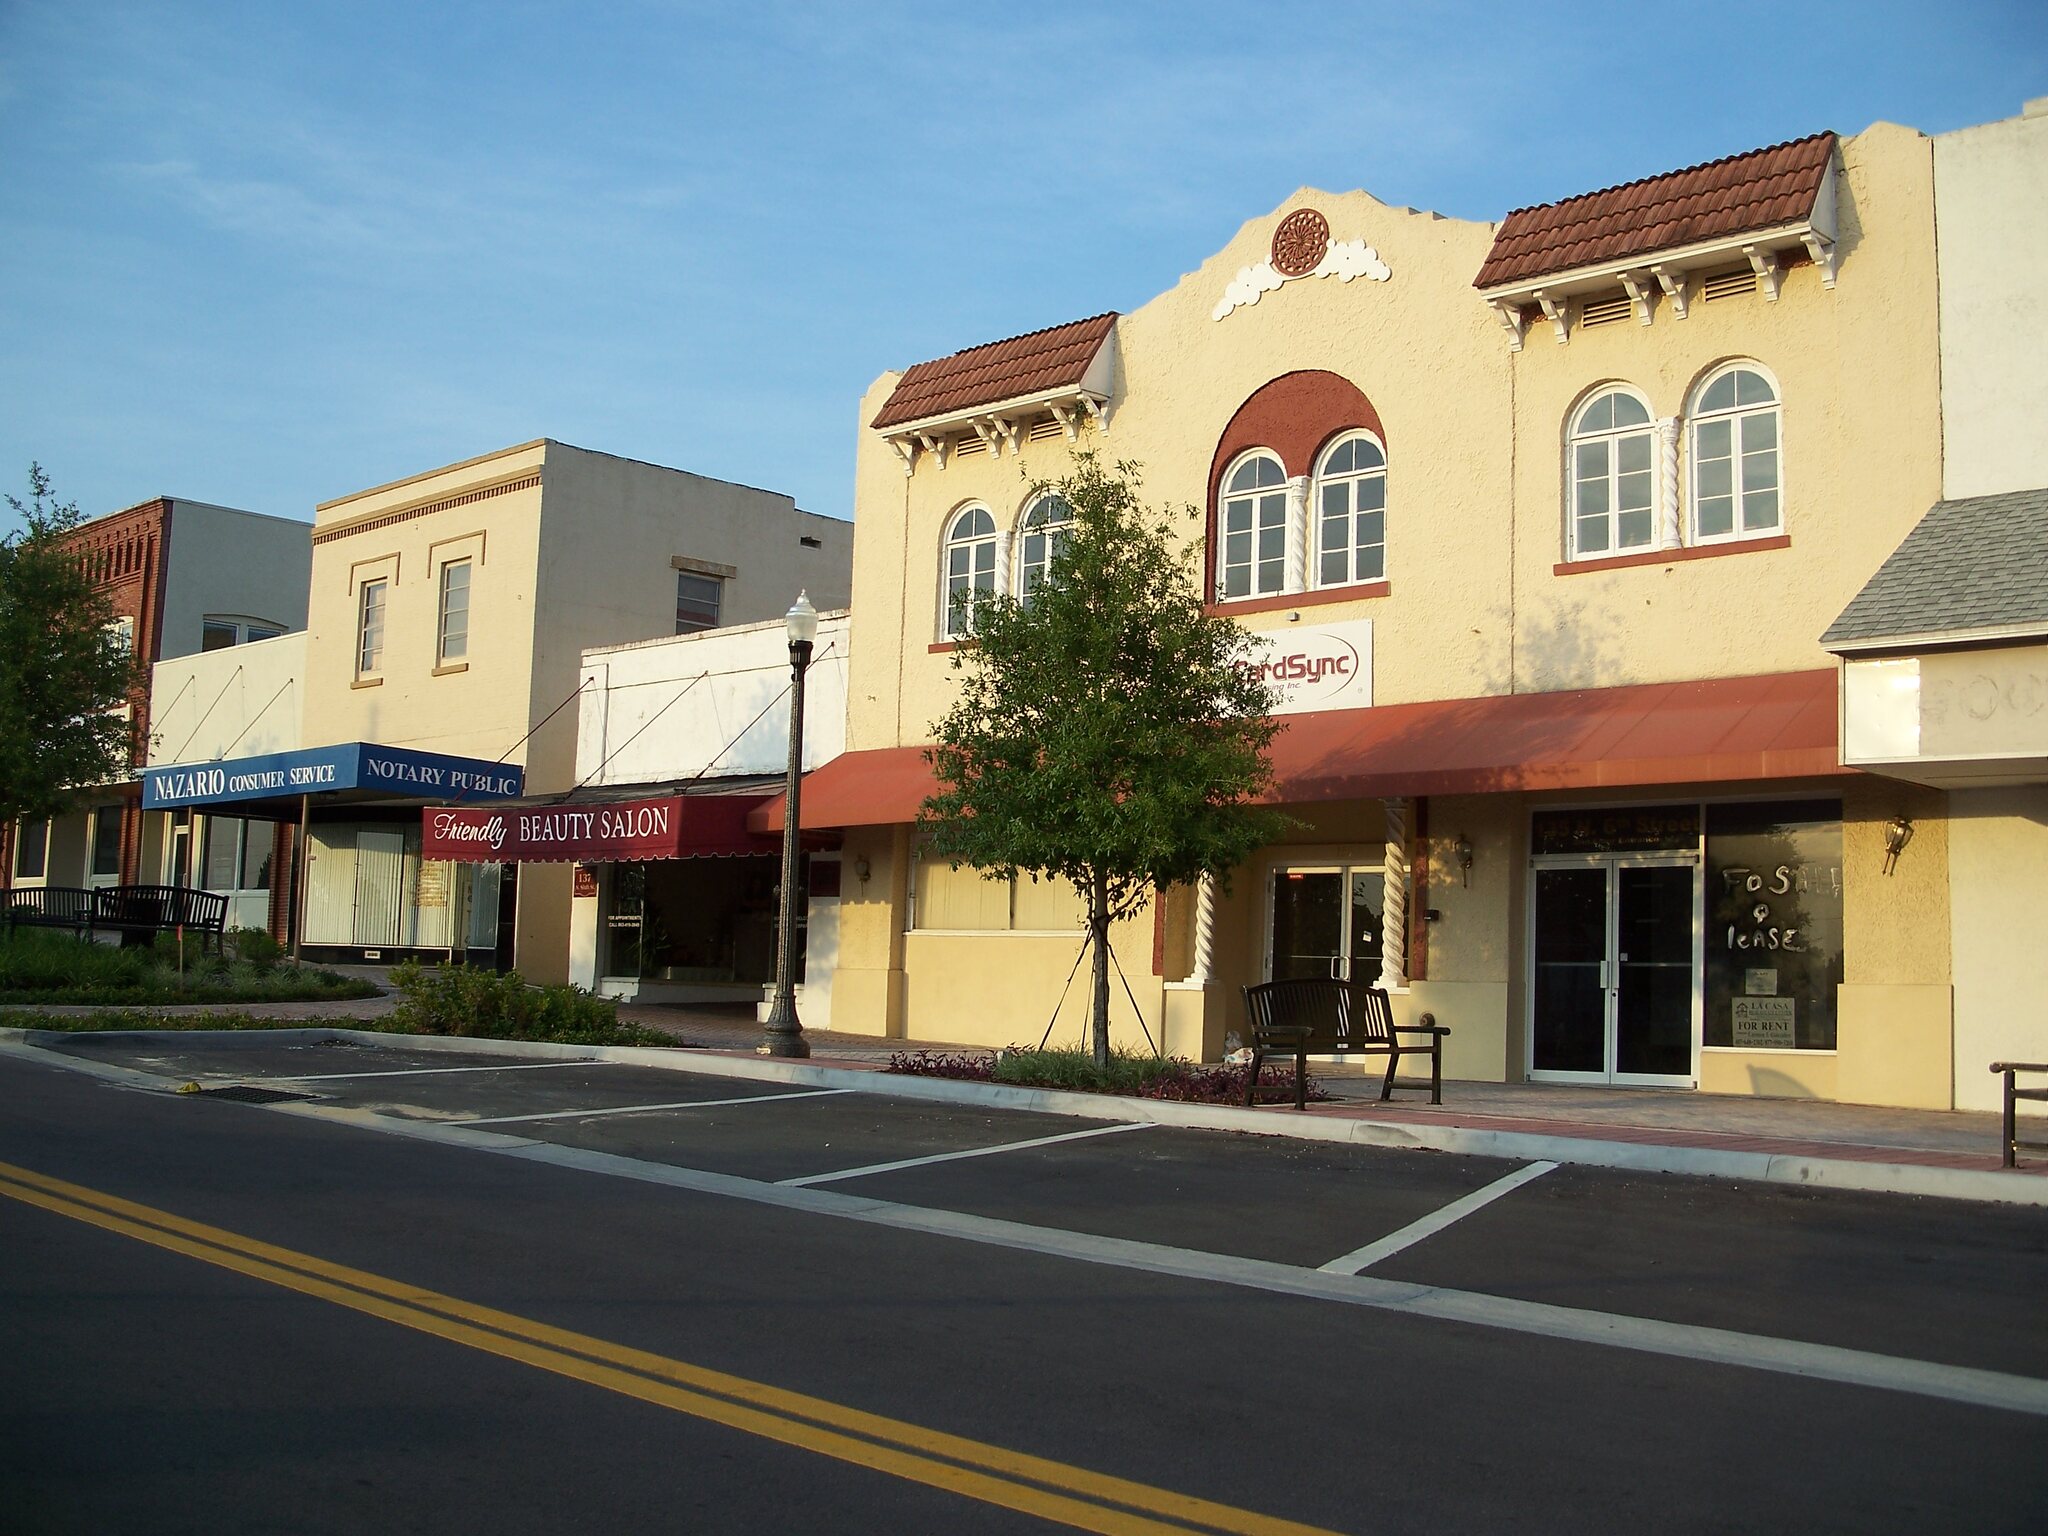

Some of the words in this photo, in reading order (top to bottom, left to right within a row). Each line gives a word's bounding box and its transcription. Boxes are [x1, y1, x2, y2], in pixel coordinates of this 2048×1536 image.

[154, 767, 225, 801] NAZARIO
[229, 771, 286, 793] CONSUMER
[289, 764, 336, 786] SERVICE
[366, 758, 446, 786] NOTARY
[450, 771, 518, 796] PUBLIC
[433, 812, 508, 851] Friendly
[518, 812, 596, 842] BEAUTY
[600, 805, 670, 839] SALON
[579, 873, 592, 883] 137
[1738, 1021, 1758, 1031] FOR
[1761, 1021, 1789, 1031] RENT
